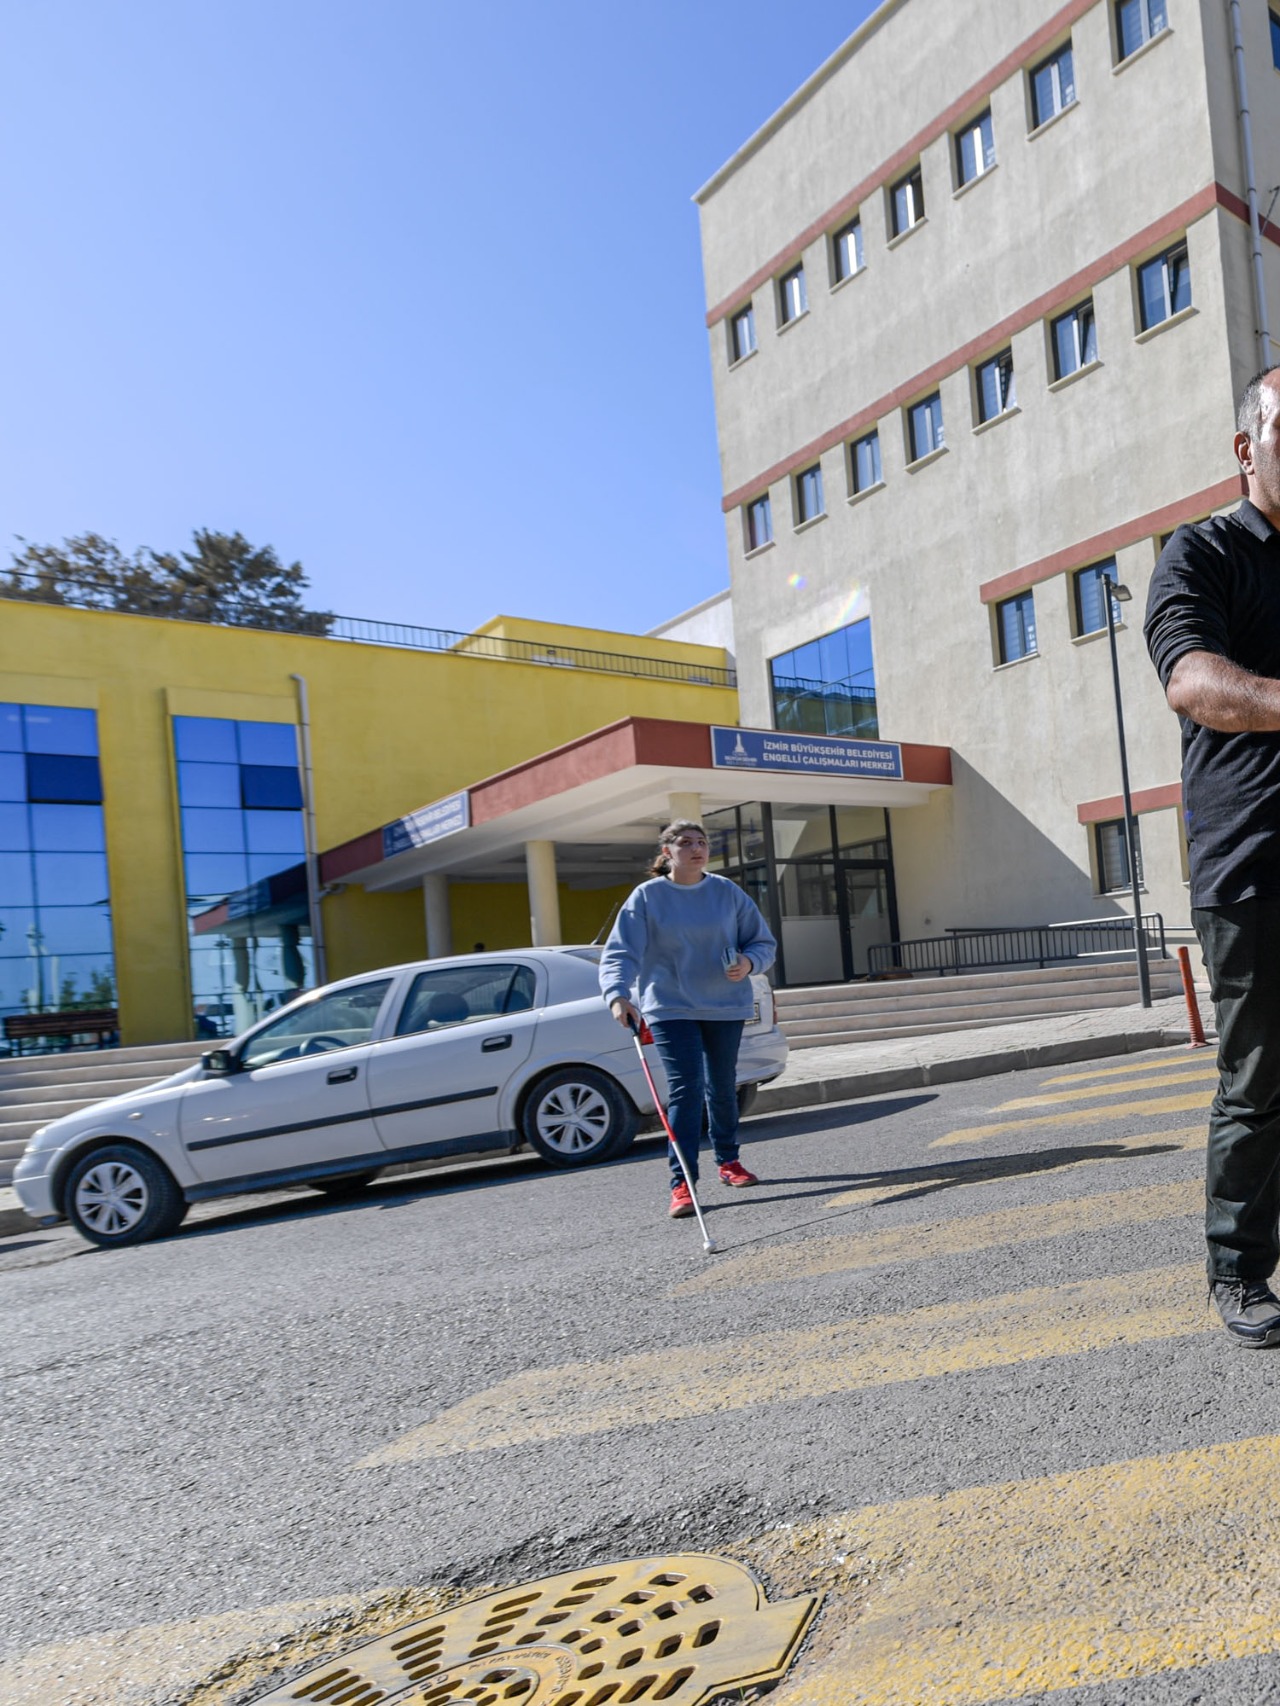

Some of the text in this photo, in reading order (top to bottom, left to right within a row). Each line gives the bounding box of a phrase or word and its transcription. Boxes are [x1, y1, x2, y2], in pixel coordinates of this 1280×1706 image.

[763, 740, 893, 760] İZMİR BÜYÜKŞEHİR BELEDİYESİ
[763, 753, 801, 763] ENGELLİ
[803, 757, 859, 768] ÇALIŞMALARI
[861, 761, 895, 771] MERKEZİ
